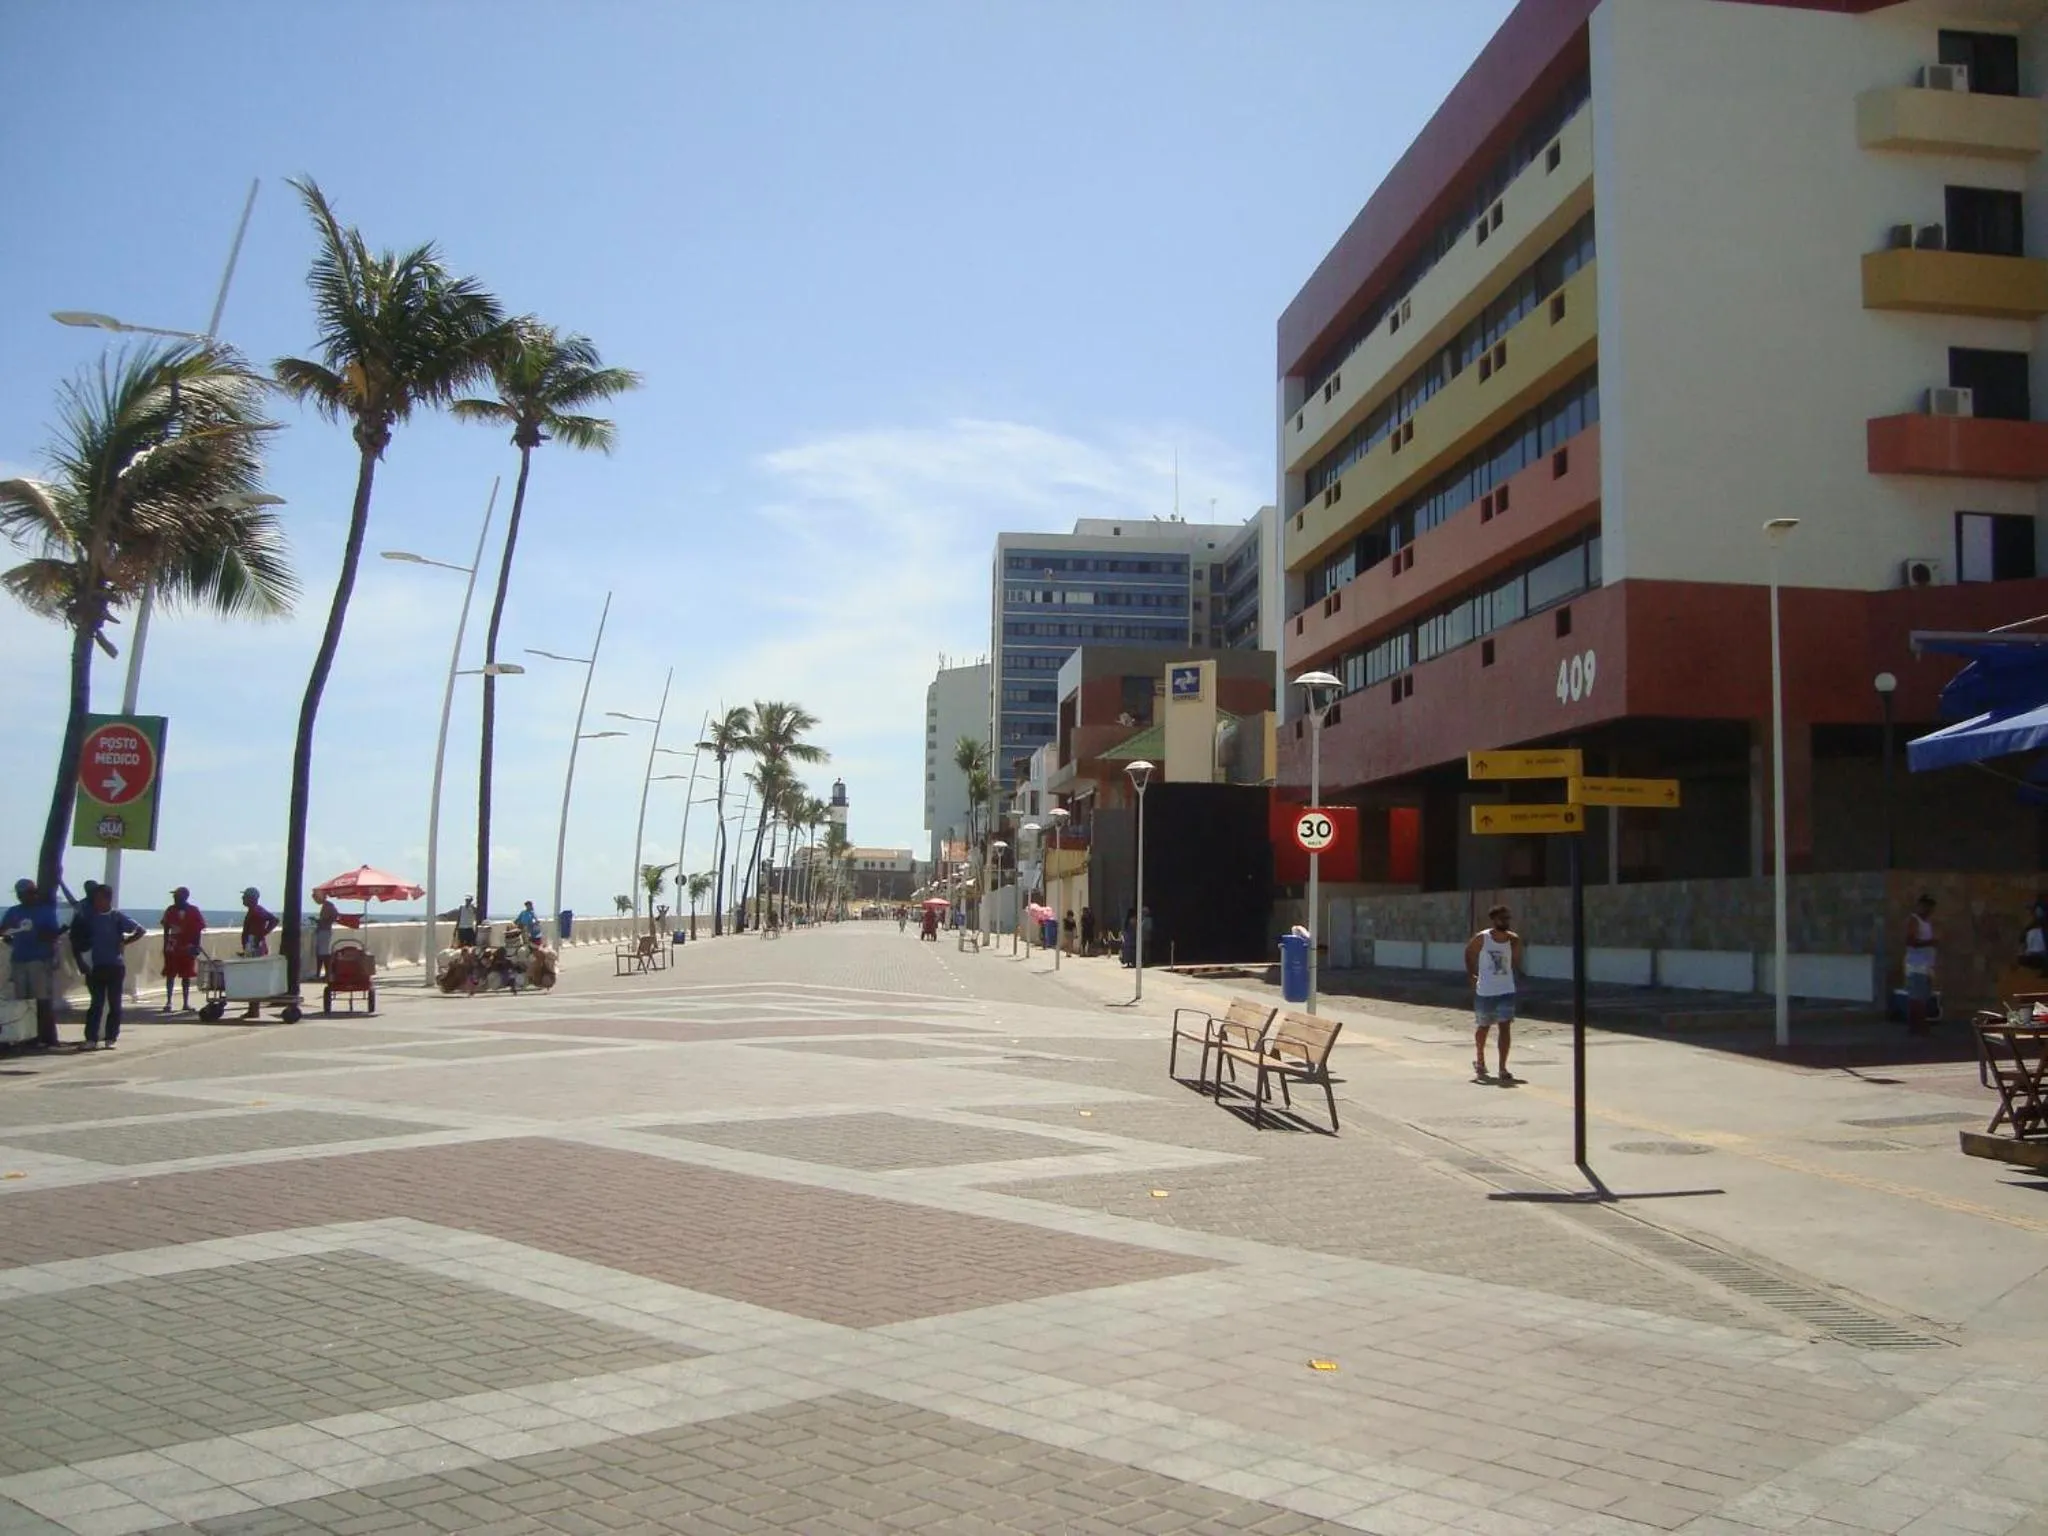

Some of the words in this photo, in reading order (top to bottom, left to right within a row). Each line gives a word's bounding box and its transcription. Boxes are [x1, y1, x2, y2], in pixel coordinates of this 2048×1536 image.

[1556, 650, 1596, 704] 409
[100, 737, 138, 750] POSTO
[1300, 820, 1332, 838] 30
